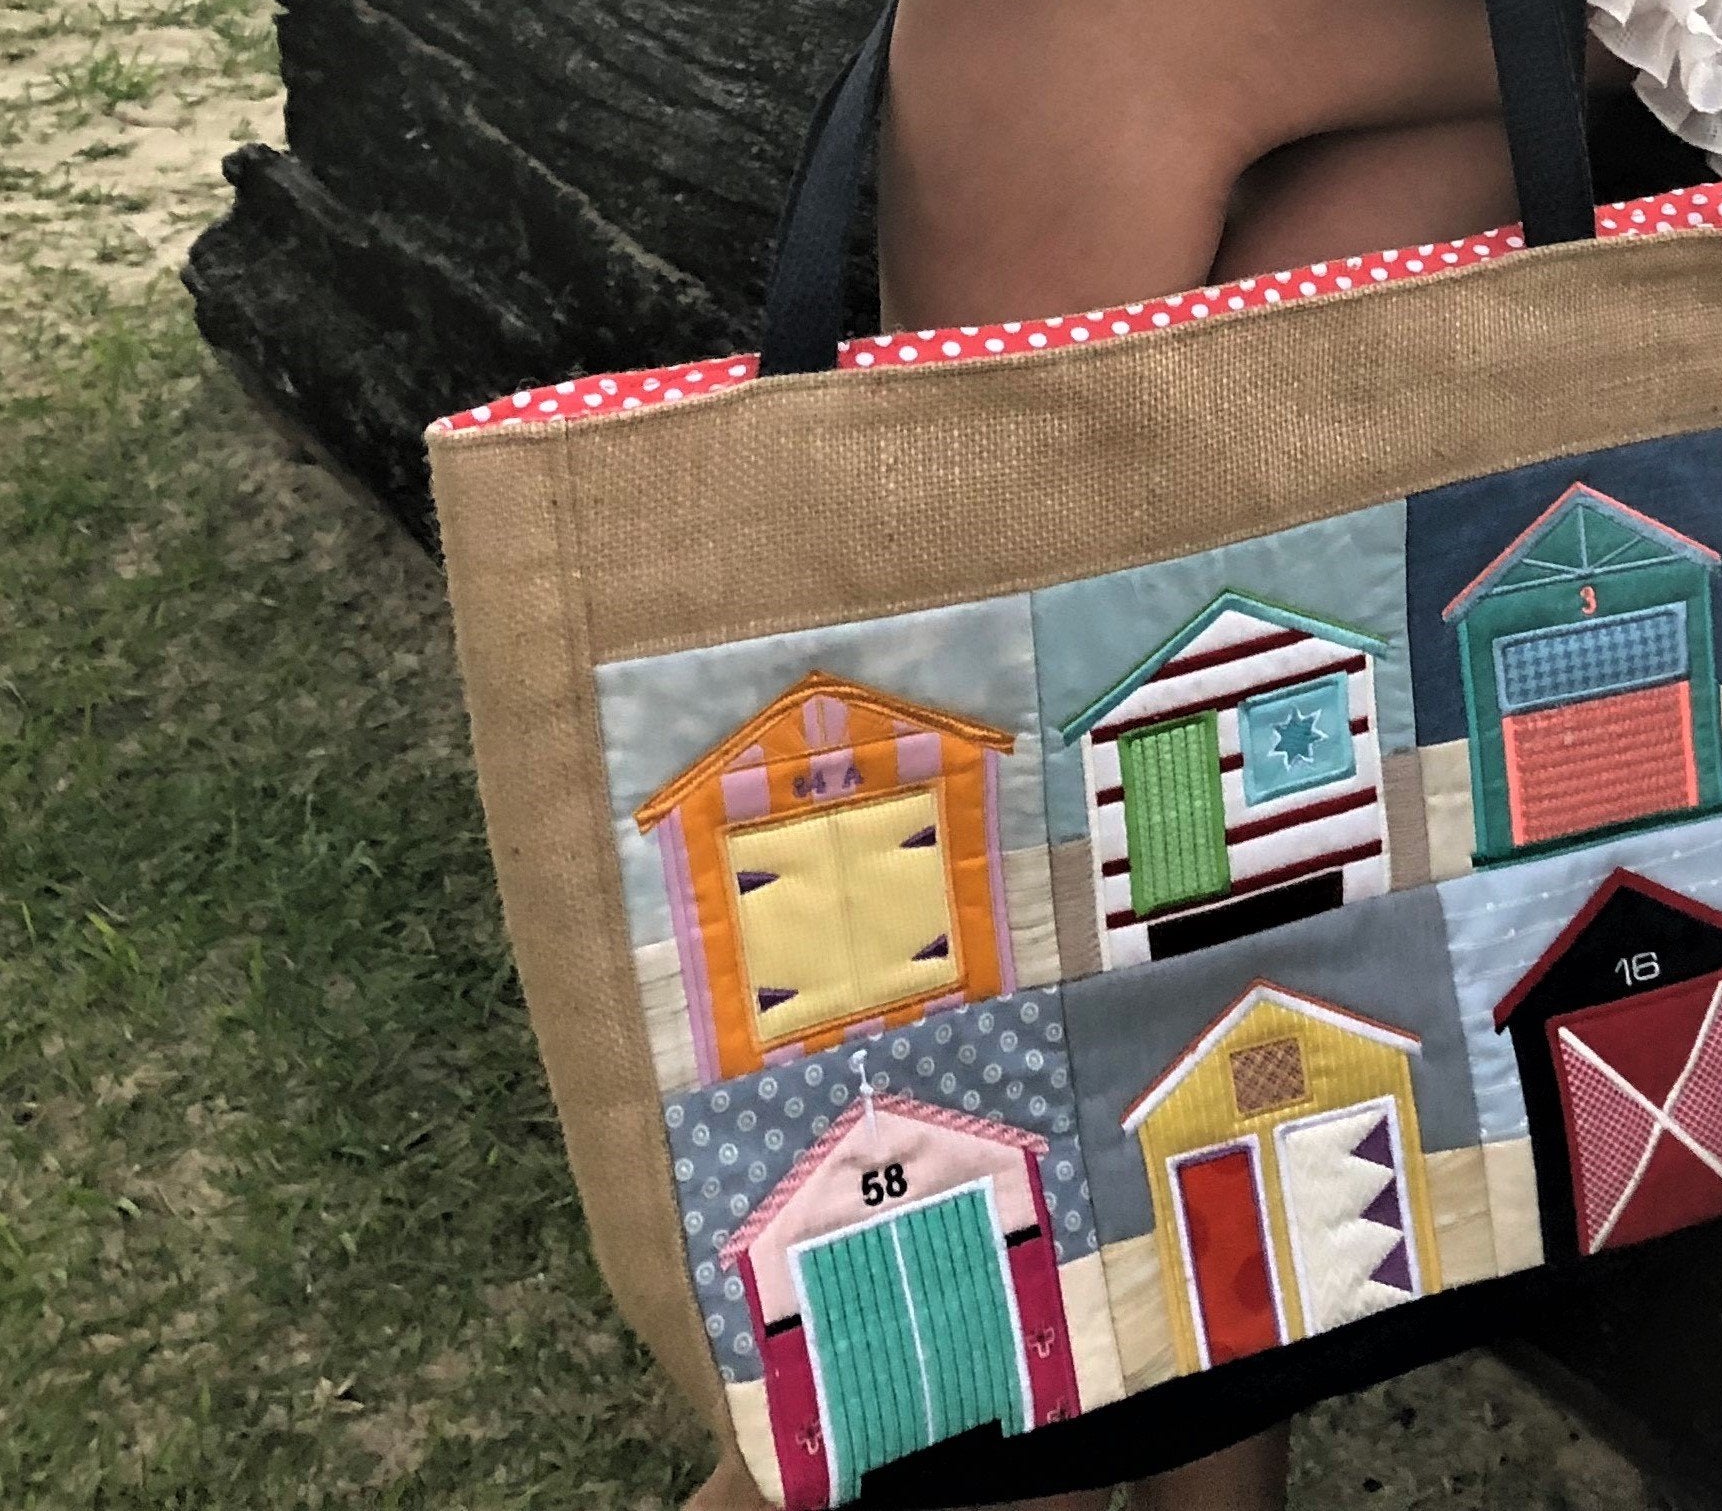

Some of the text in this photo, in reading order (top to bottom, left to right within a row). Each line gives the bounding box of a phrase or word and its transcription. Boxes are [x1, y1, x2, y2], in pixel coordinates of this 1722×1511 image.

[1579, 586, 1598, 615] 3
[841, 764, 865, 790] A
[1614, 951, 1661, 987] 16
[862, 1163, 908, 1207] 58
